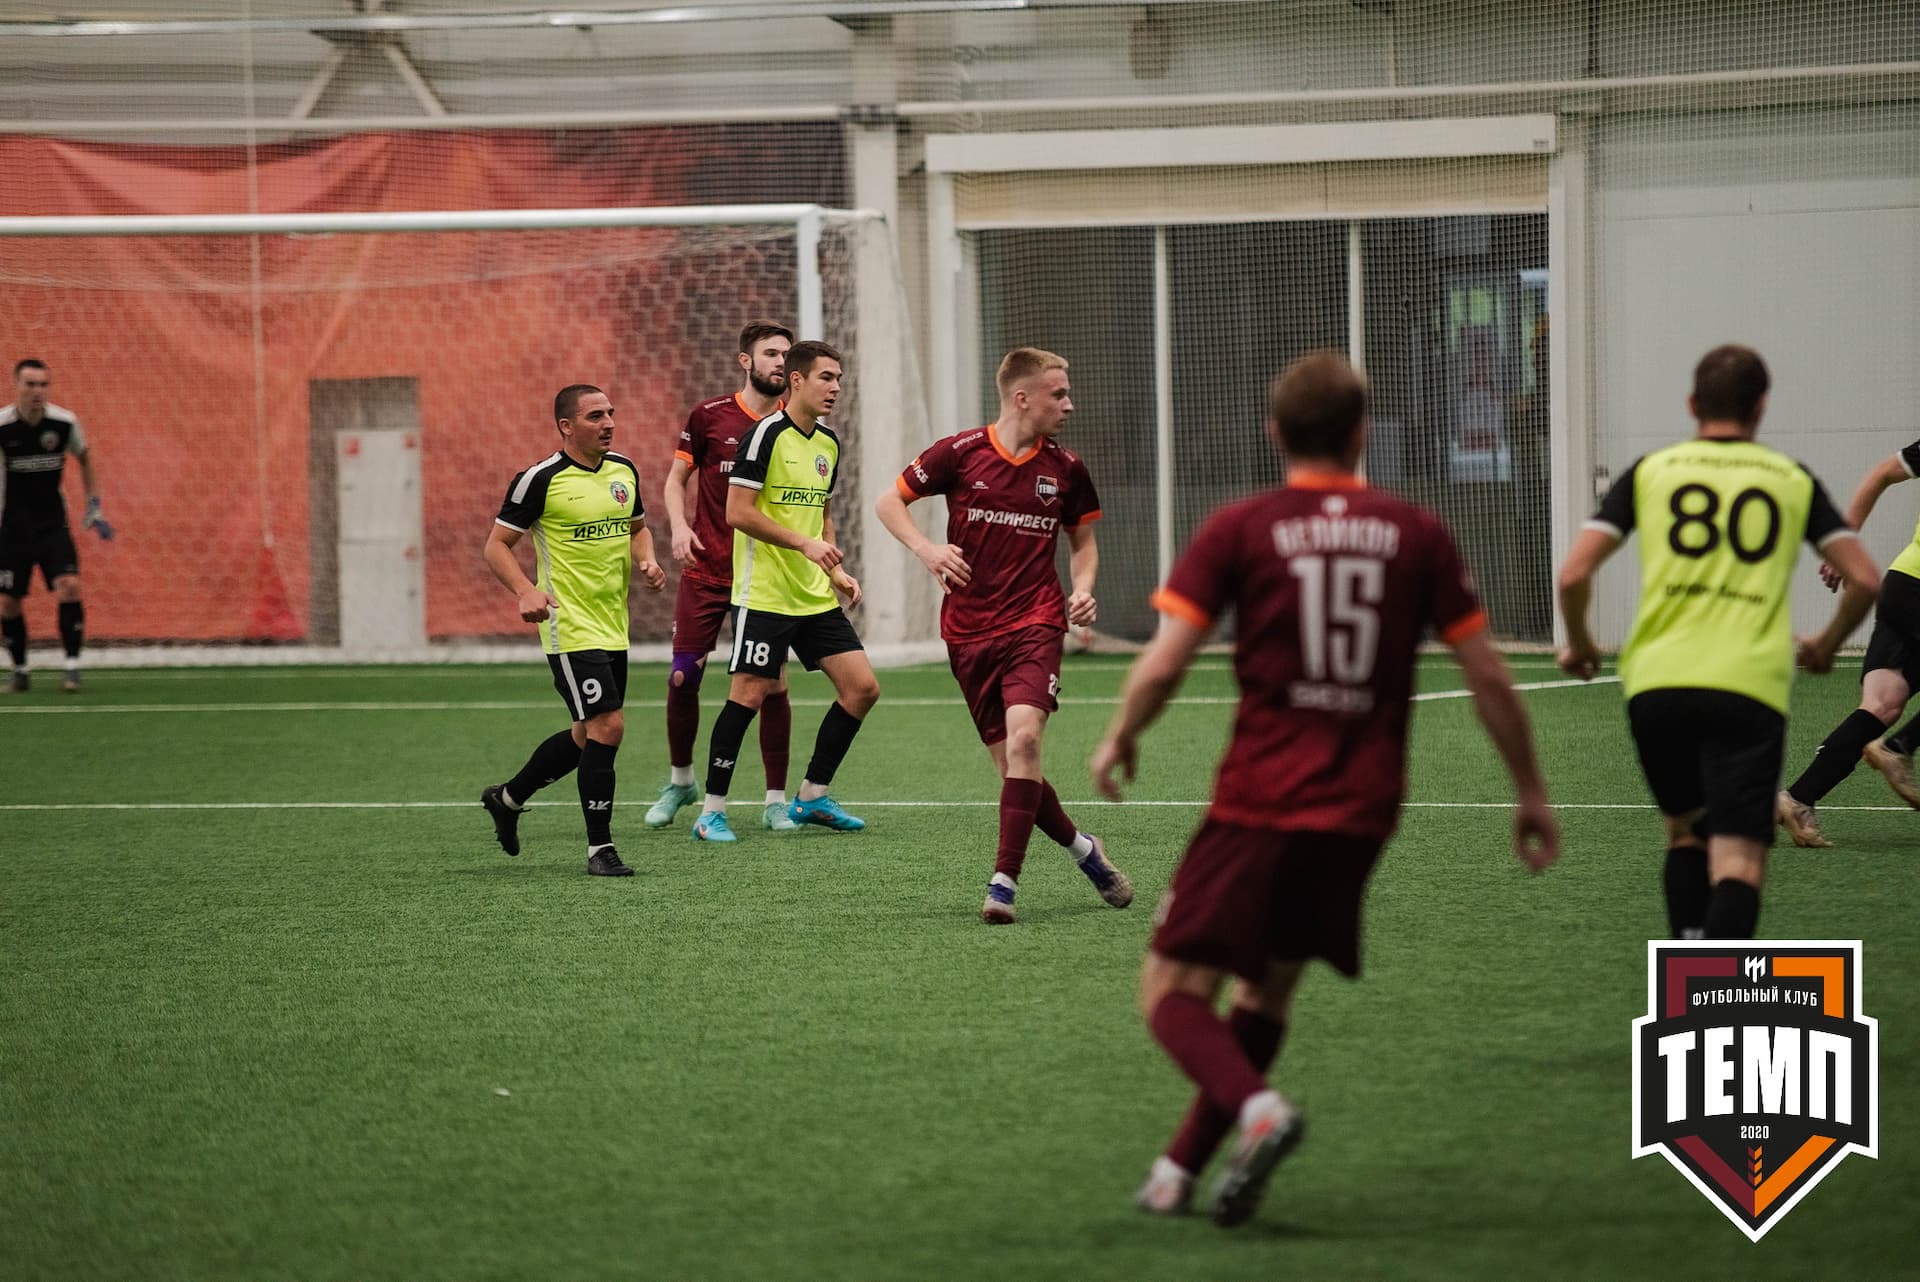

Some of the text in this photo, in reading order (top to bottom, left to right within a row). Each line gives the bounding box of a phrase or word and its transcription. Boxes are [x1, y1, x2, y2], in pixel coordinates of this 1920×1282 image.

[574, 521, 631, 538] ИРКУТС
[967, 508, 1058, 531] ПРОДИНВЕСТ
[1669, 482, 1781, 565] 80
[1287, 554, 1386, 683] 15
[745, 640, 770, 667] 18
[582, 678, 602, 704] 9
